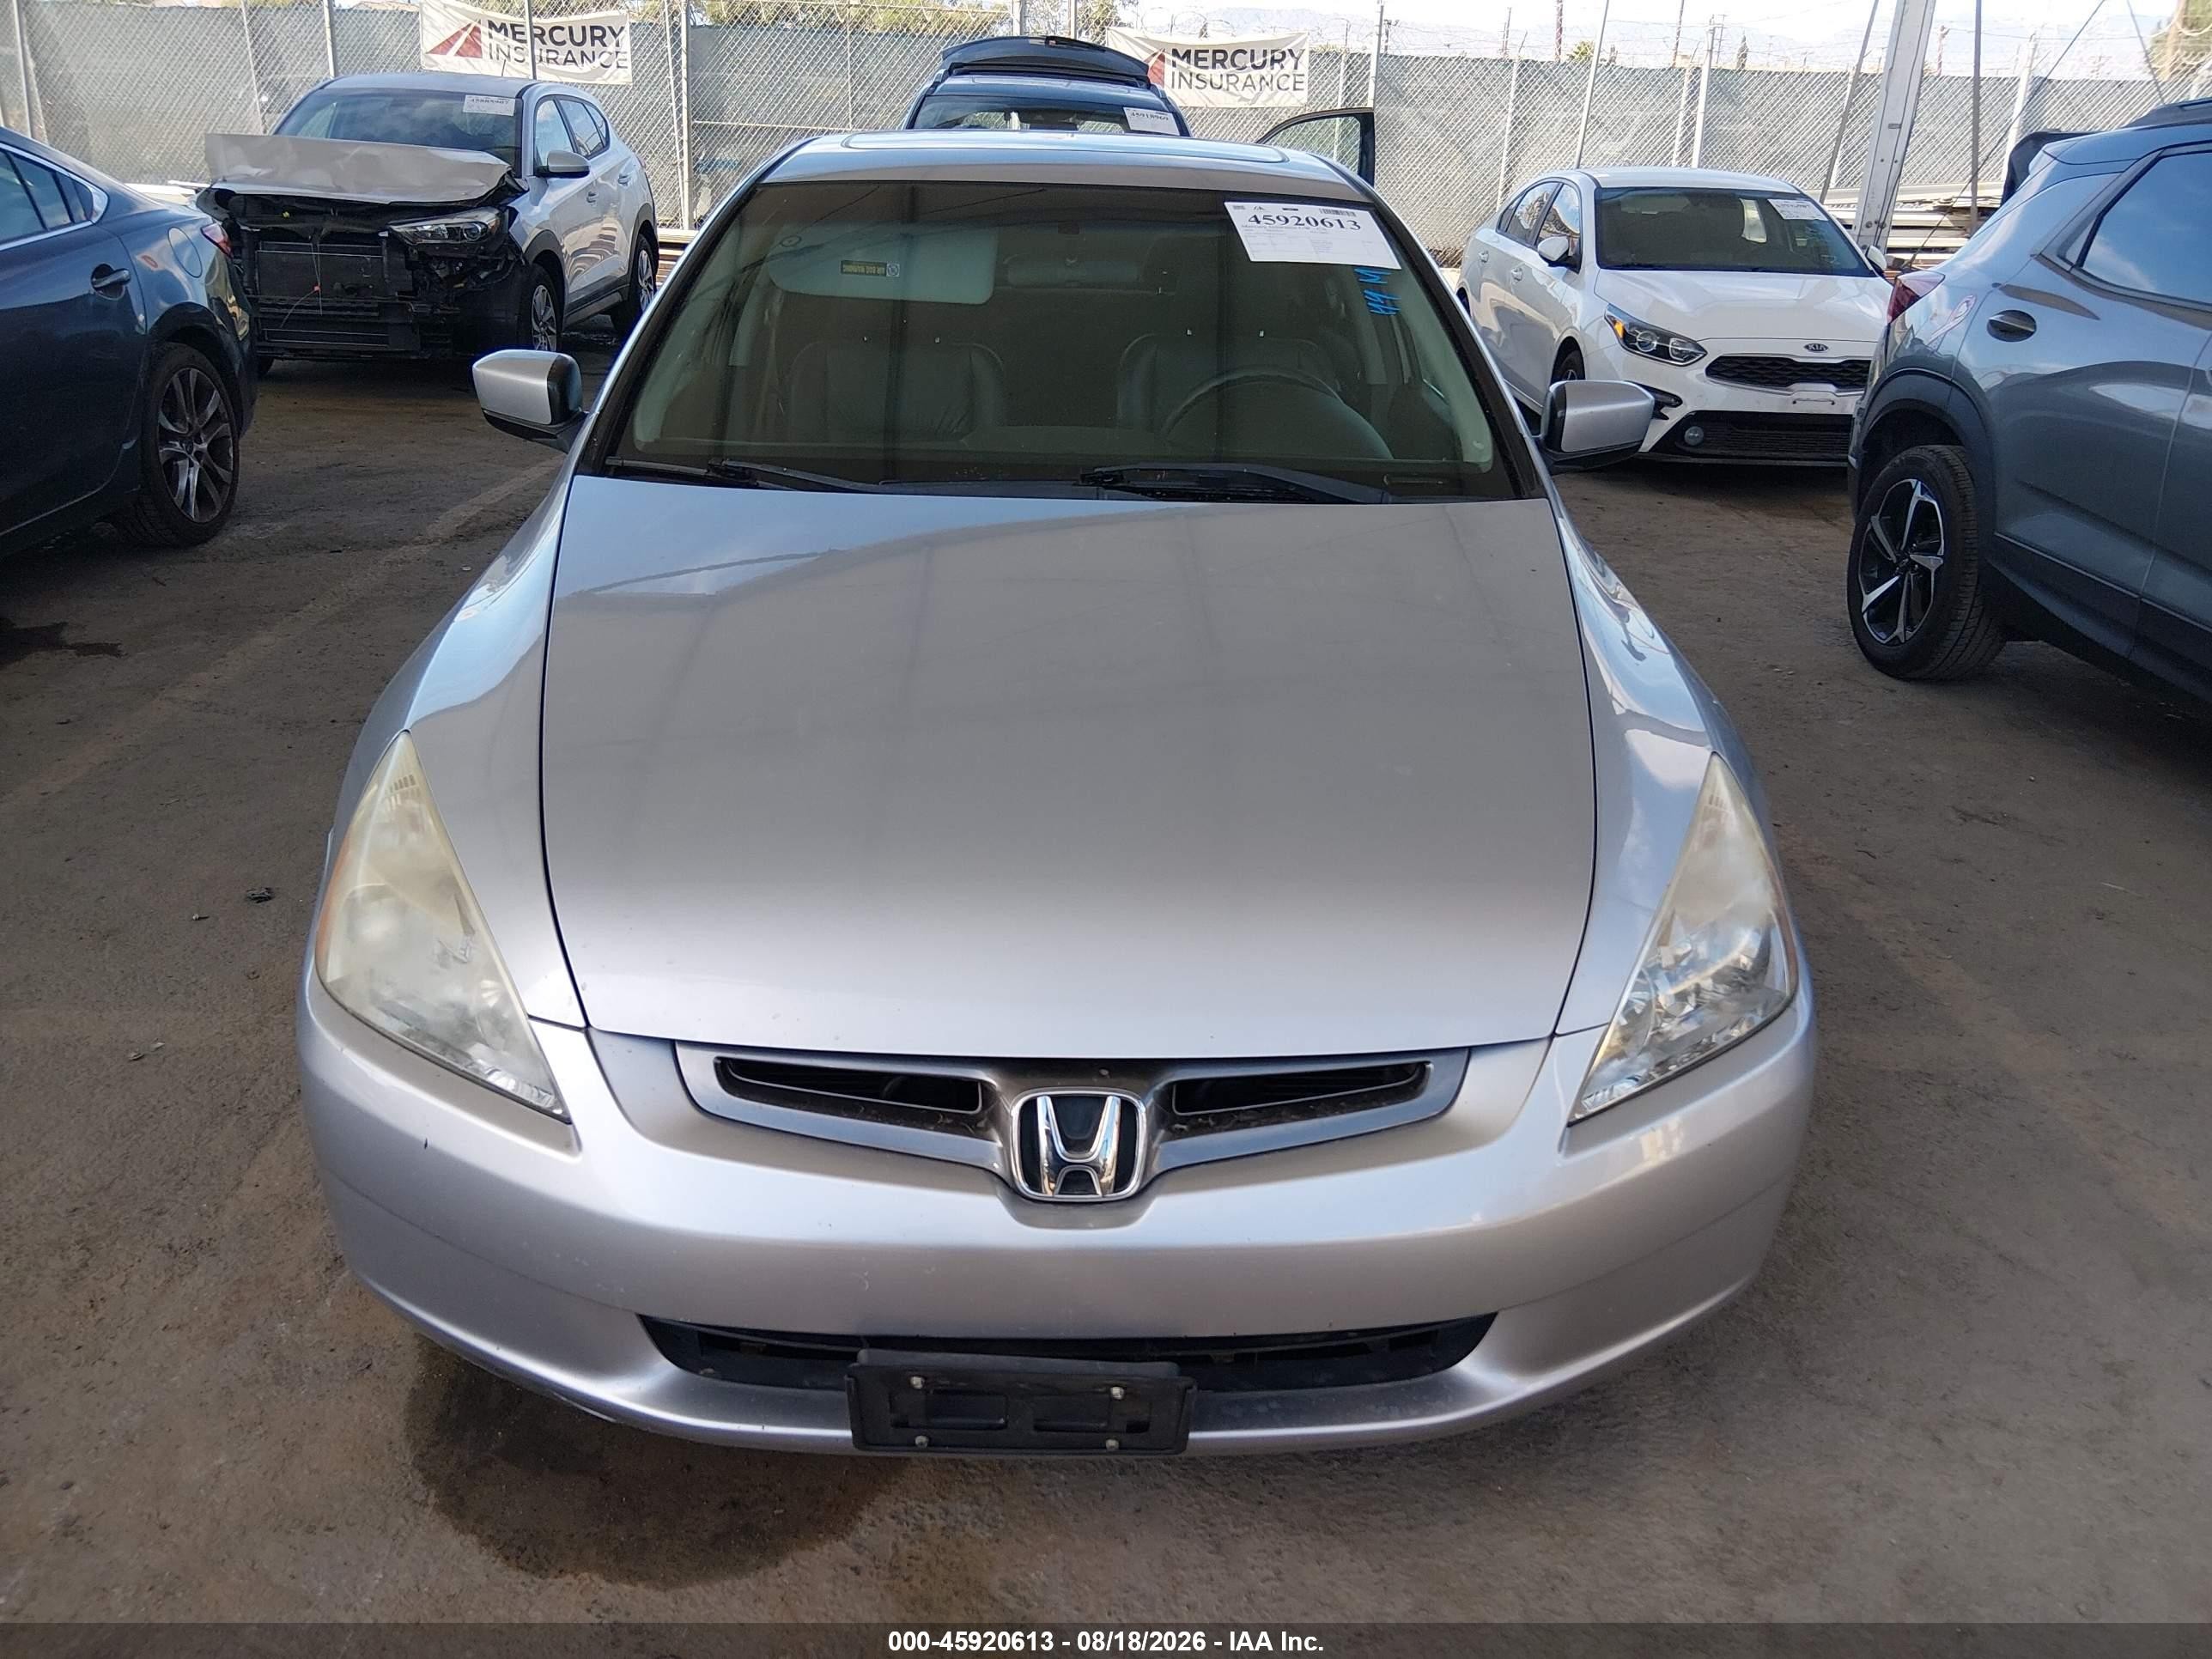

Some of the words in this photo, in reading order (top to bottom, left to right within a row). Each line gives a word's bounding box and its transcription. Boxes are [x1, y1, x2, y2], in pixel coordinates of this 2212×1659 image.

[487, 19, 625, 47] MERCURY
[1171, 48, 1305, 71] MERCURY
[1171, 72, 1305, 91] INSURANCE
[1248, 214, 1361, 231] 45920613
